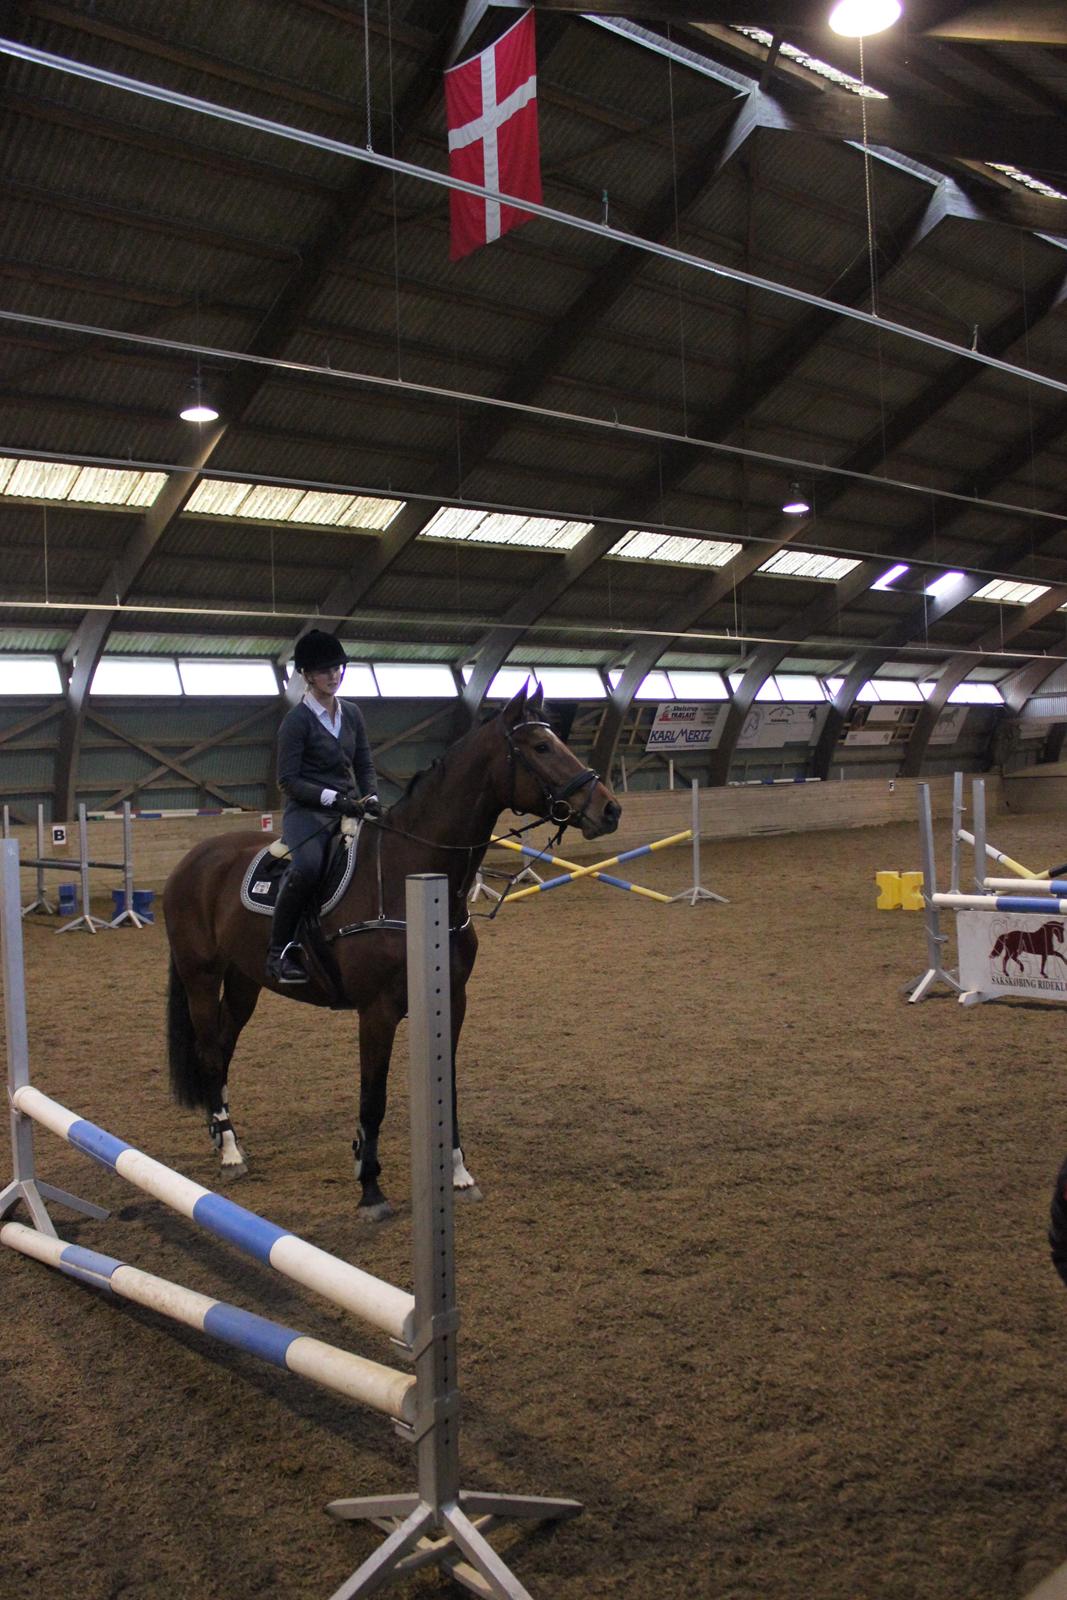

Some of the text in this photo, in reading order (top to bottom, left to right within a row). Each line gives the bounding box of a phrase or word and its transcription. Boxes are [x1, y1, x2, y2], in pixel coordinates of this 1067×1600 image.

[650, 728, 712, 742] KARL MERTZ
[262, 817, 271, 828] F
[54, 829, 65, 841] B
